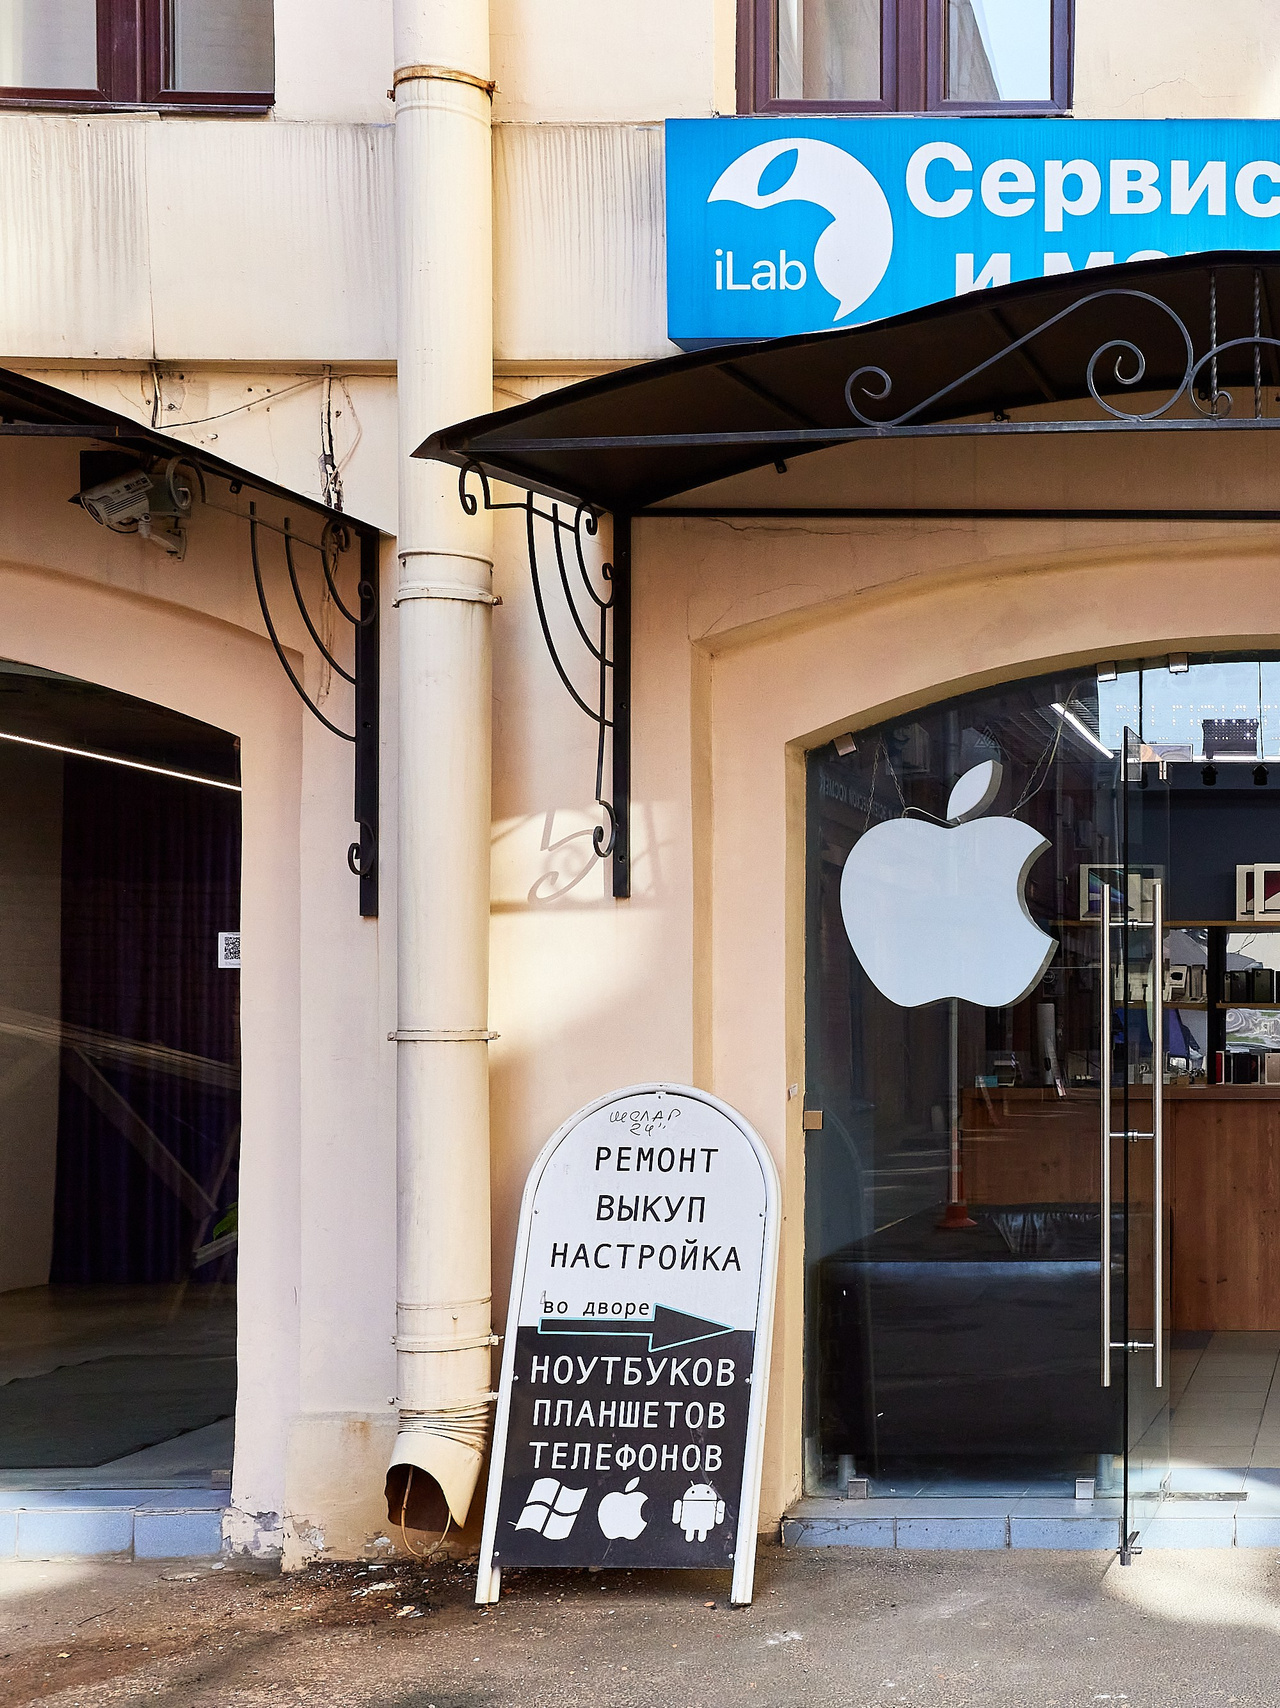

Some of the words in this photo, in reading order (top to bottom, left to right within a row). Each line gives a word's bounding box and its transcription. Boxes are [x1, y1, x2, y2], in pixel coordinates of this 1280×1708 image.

[715, 249, 808, 291] iLab
[595, 1146, 719, 1173] РЕМОНТ
[596, 1195, 706, 1223] ВЫКУП
[550, 1238, 741, 1272] НАСТРОЙКА
[543, 1301, 568, 1314] во
[582, 1301, 650, 1319] дворе
[530, 1355, 736, 1387] НОУТБУКОВ
[532, 1399, 726, 1429] ПЛАНШЕТОВ
[528, 1441, 723, 1472] ТЕЛЕФОНОВ
